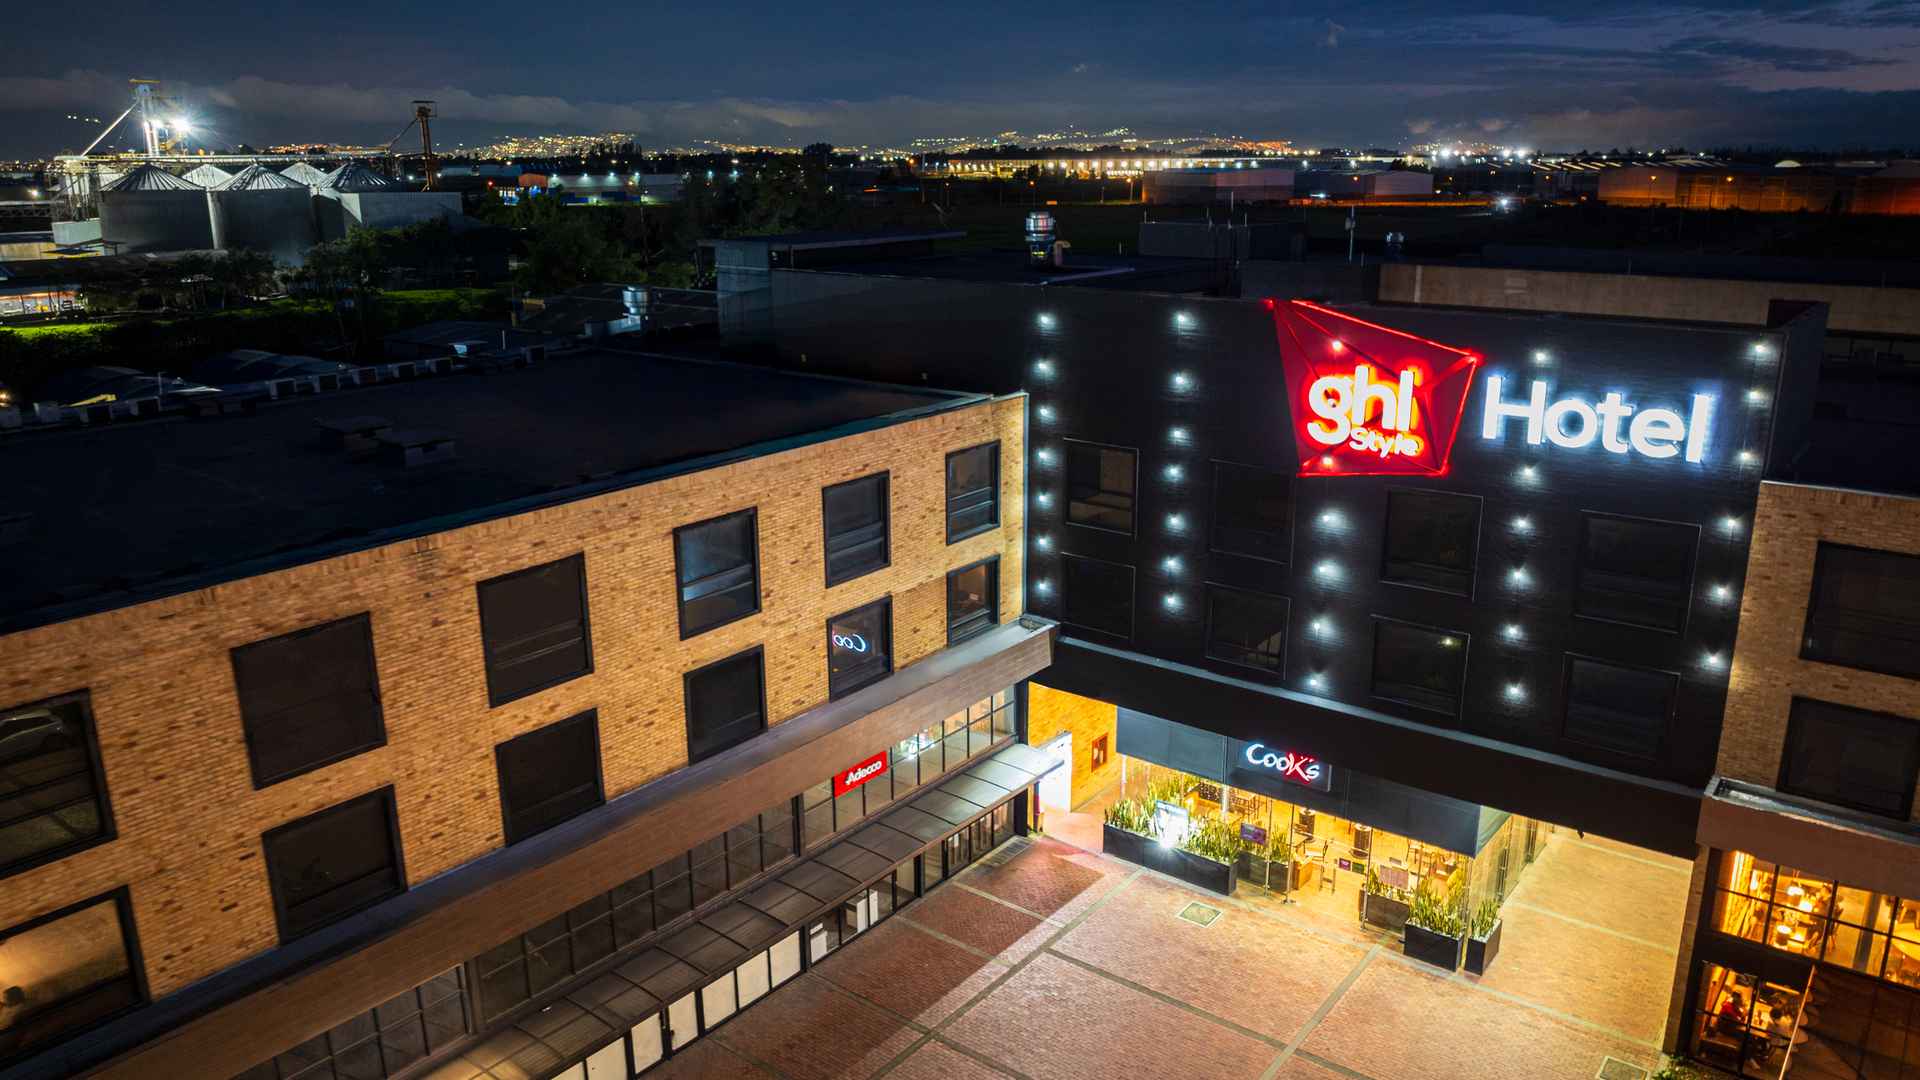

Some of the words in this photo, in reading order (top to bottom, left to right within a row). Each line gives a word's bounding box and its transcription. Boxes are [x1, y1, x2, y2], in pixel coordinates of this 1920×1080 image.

[1307, 365, 1414, 445] ghl
[1482, 376, 1714, 463] Hotel
[1348, 427, 1421, 458] Style
[845, 760, 882, 786] Adecco
